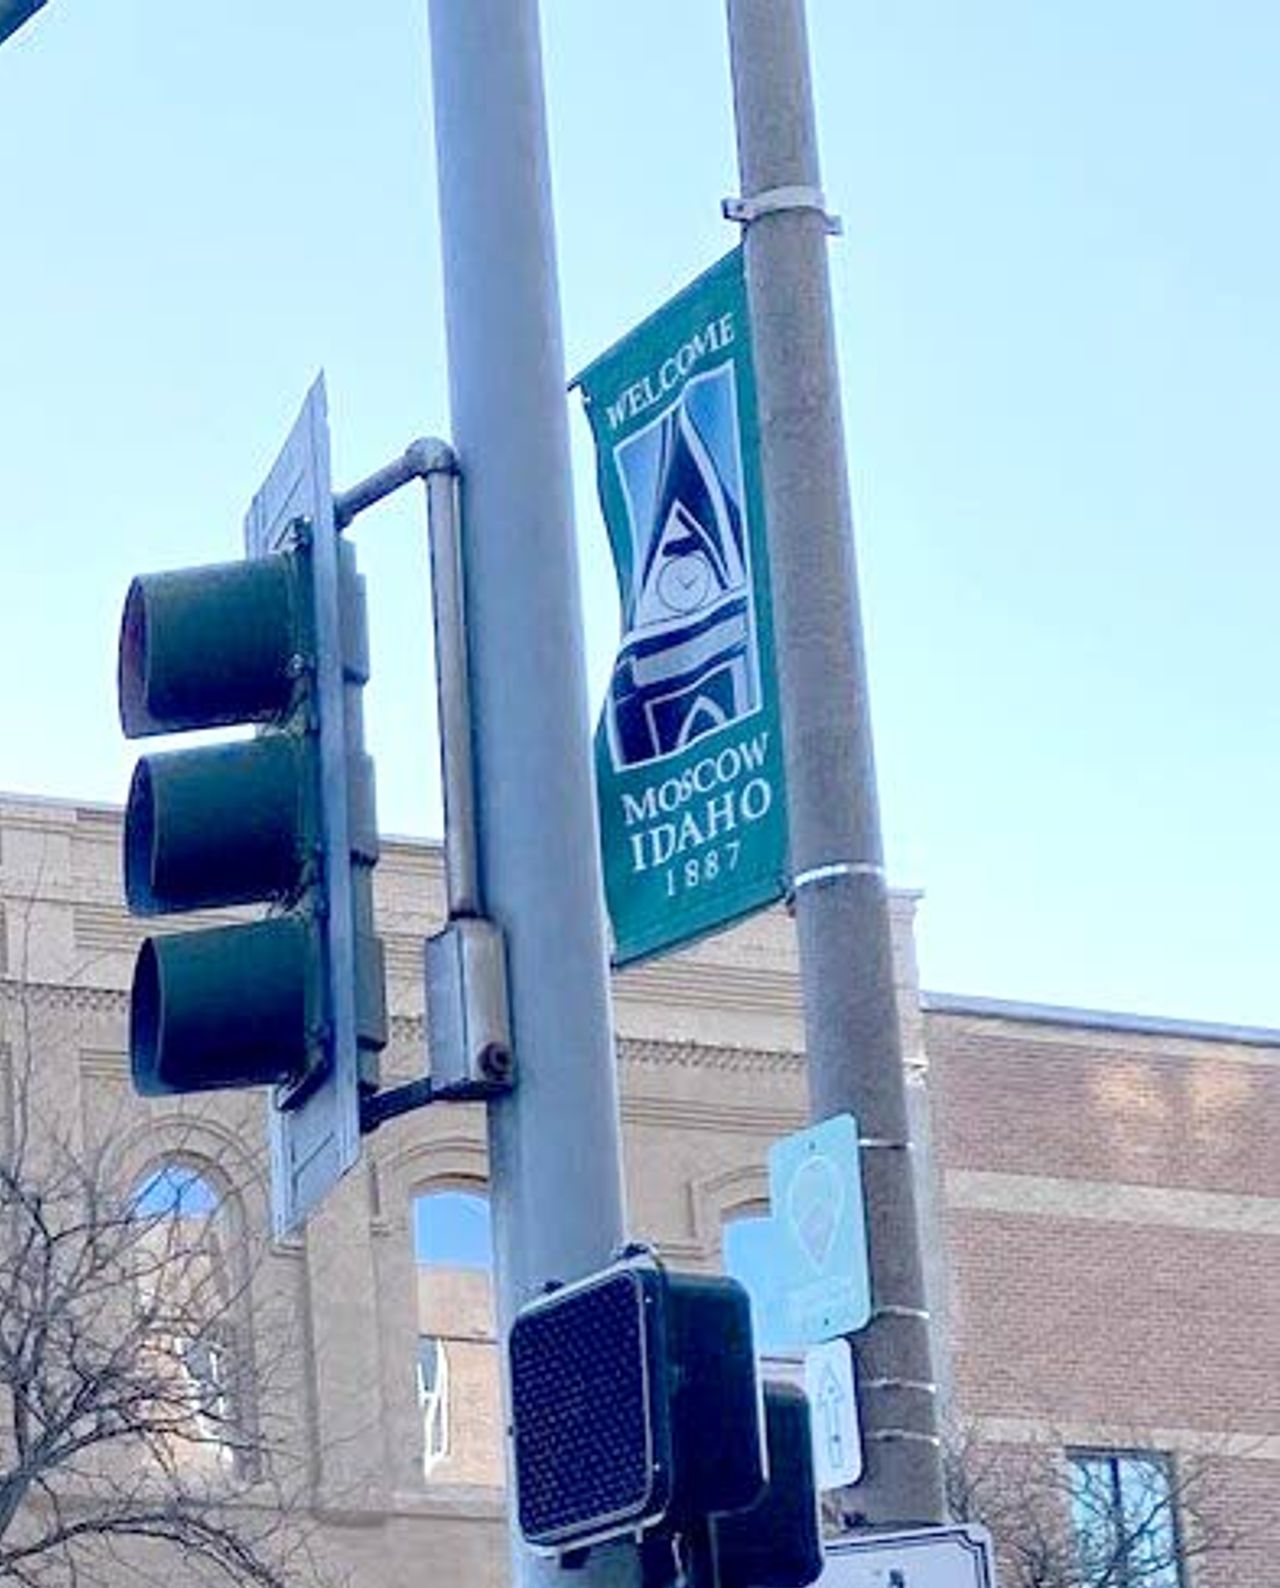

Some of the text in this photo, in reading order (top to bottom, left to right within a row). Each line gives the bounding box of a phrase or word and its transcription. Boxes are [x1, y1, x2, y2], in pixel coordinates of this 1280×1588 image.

[607, 312, 735, 429] WELCOME
[621, 732, 768, 825] MOSCOW
[630, 778, 771, 872] IDAHO
[666, 841, 740, 896] 1887
